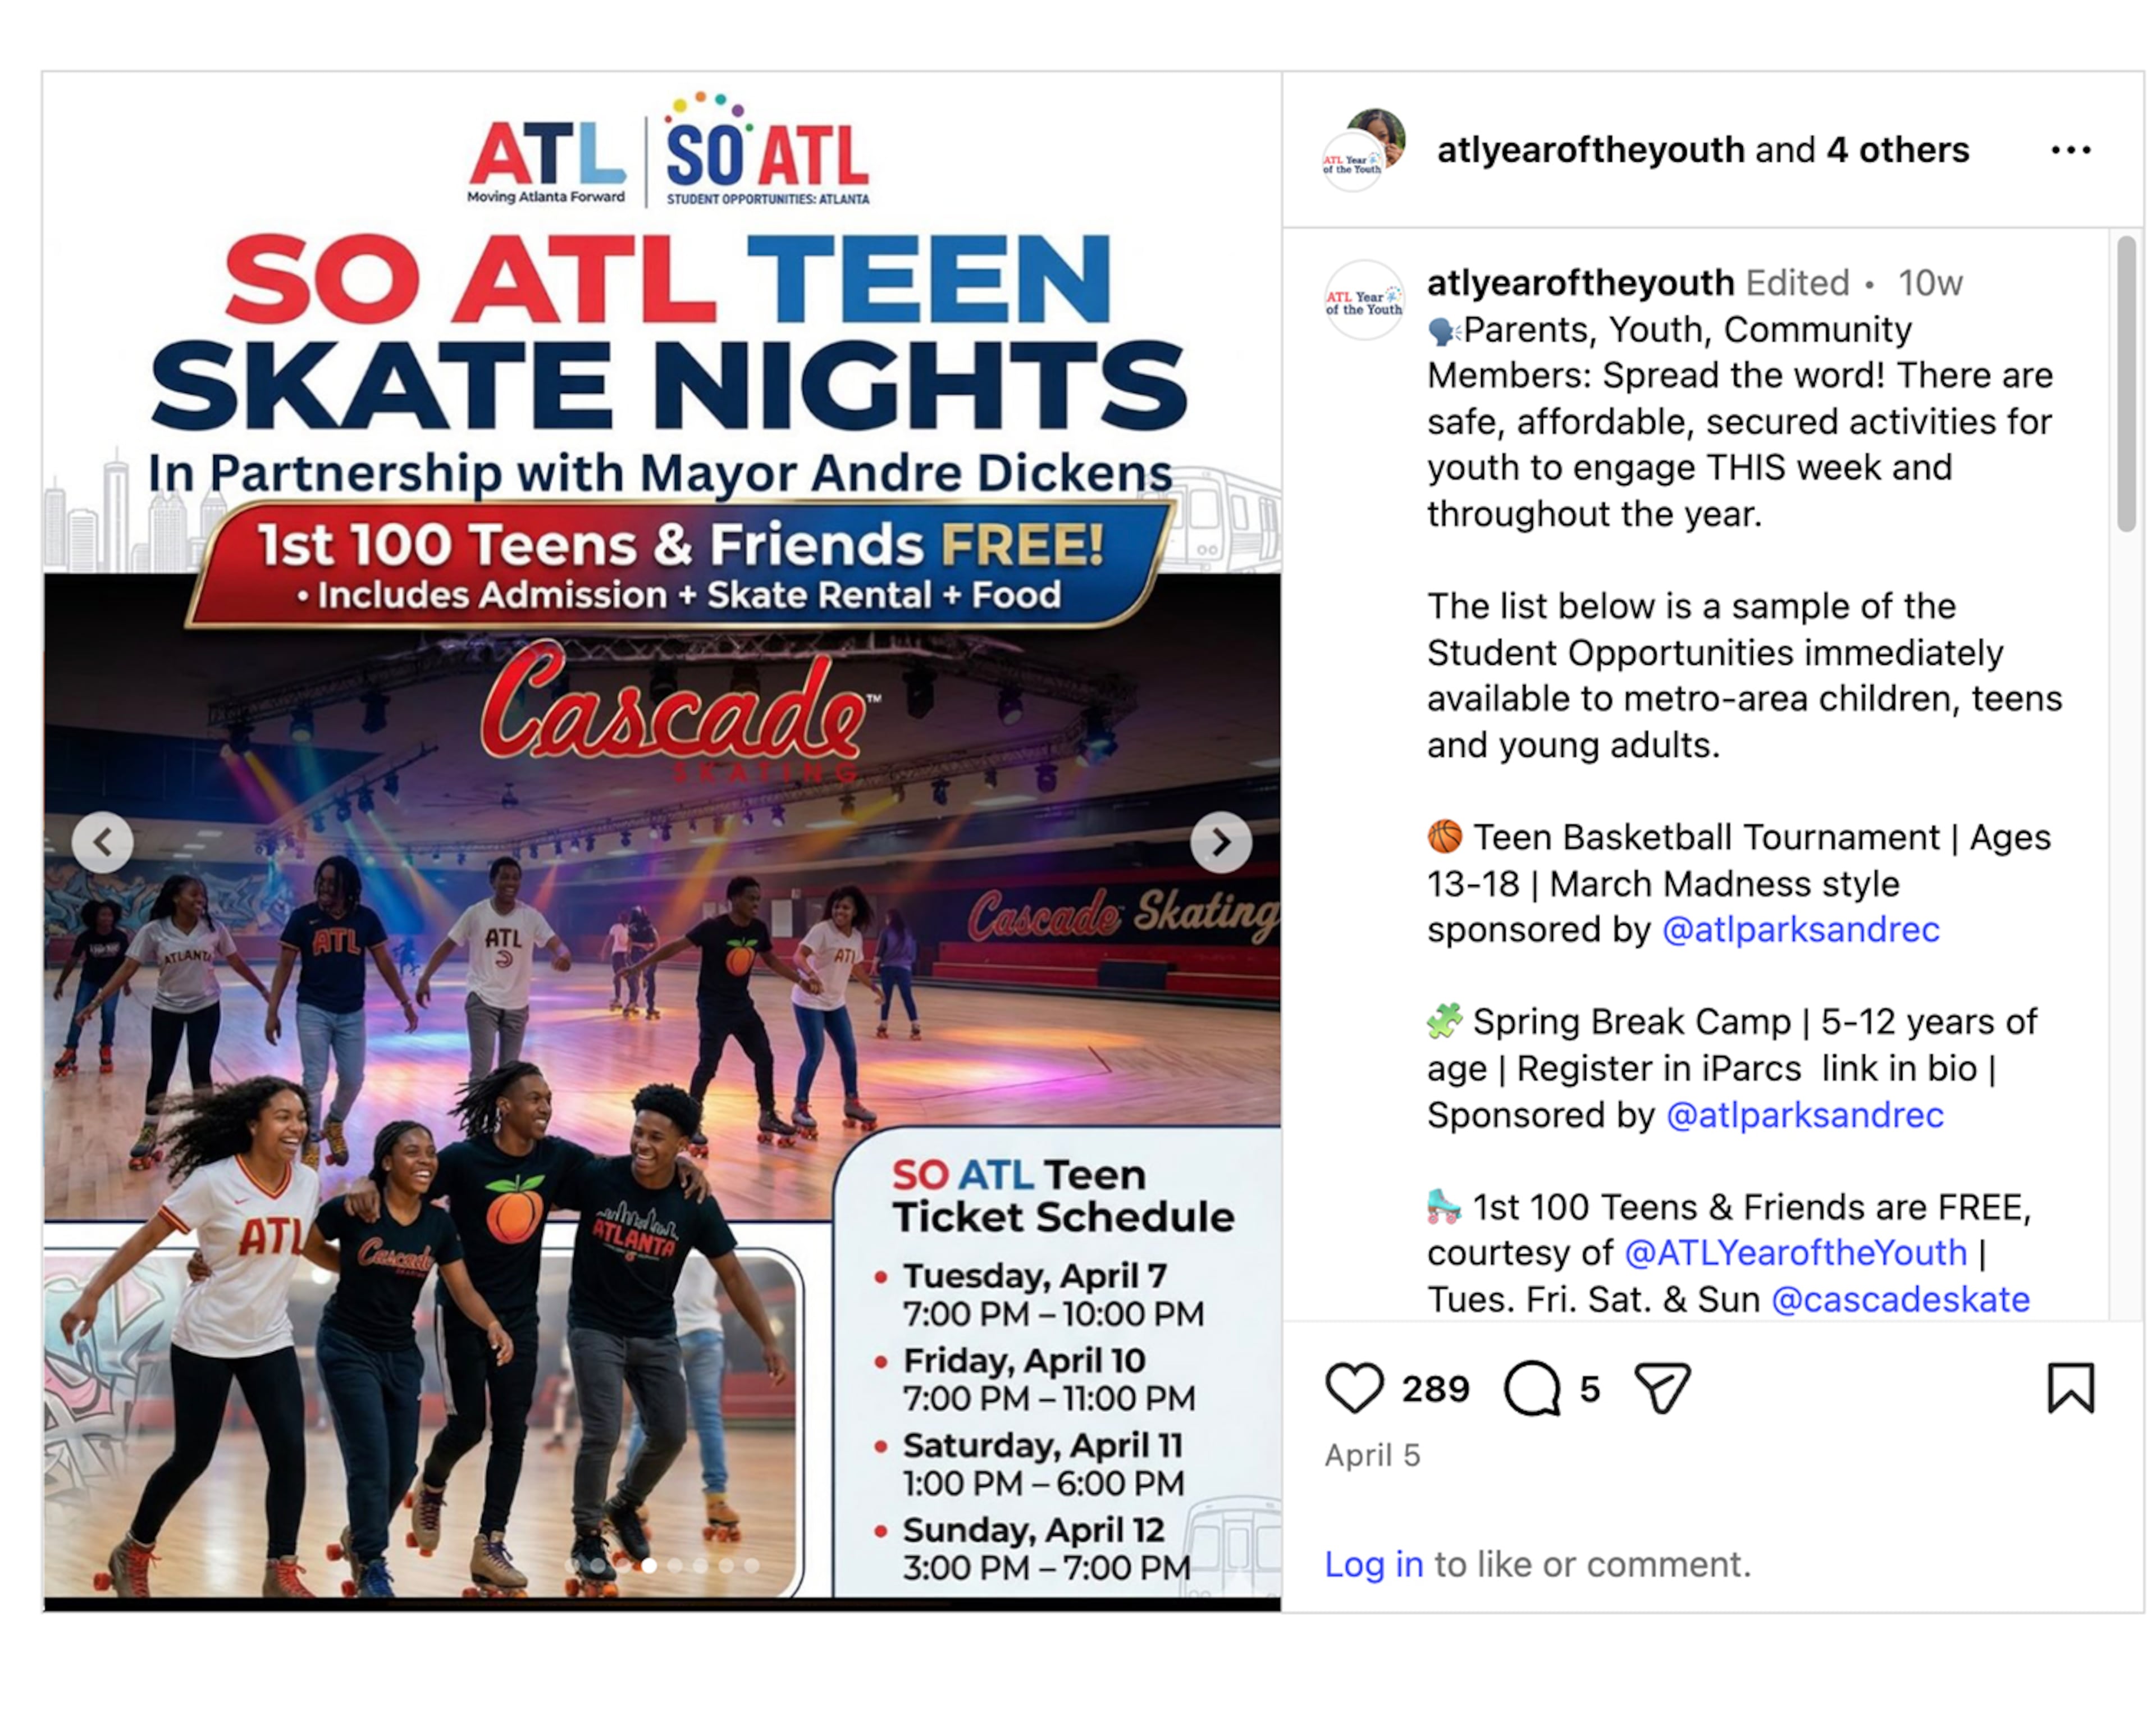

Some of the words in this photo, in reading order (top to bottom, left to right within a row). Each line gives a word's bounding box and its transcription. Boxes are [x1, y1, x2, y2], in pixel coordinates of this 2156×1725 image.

[469, 121, 627, 185] ATL
[666, 124, 744, 186] SO
[758, 125, 870, 185] ATL
[1323, 165, 1333, 174] of
[1336, 165, 1352, 174] the
[1354, 165, 1382, 174] Youth
[1346, 156, 1367, 165] Year
[1438, 134, 1745, 170] atlyearoftheyouth
[1756, 135, 1815, 163] and
[1826, 136, 1849, 163] 4
[1860, 135, 1970, 163] others
[467, 190, 517, 206] Moving
[518, 190, 568, 203] Atlanta
[570, 190, 625, 203] Forward
[667, 193, 720, 205] STUDENT
[722, 193, 817, 205] OPPORTUNITIES:
[819, 193, 870, 205] ATLANTA
[225, 232, 421, 325] SO
[450, 234, 718, 324] ATL
[747, 234, 1111, 324] TEEN
[1427, 267, 1734, 303] atlyearoftheyouth
[1748, 268, 1849, 296] Edited
[1899, 268, 1963, 296] 10w
[1326, 291, 1353, 303] ATL
[1356, 291, 1384, 303] Year
[1326, 304, 1339, 315] of
[1343, 304, 1364, 315] the
[1367, 304, 1403, 315] Youth
[1465, 316, 1596, 349] Parents,
[1609, 314, 1711, 349] Youth,
[1724, 314, 1913, 350] Community
[150, 339, 613, 432] SKATE
[655, 339, 1188, 432] NIGHTS
[1429, 360, 1591, 389] Members:
[1604, 360, 1718, 395] Spread
[1730, 360, 1783, 389] the
[1793, 360, 1884, 389] word!
[1897, 360, 1991, 389] There
[2003, 367, 2053, 389] are
[150, 453, 193, 492] In
[212, 452, 502, 500] Partnership
[517, 452, 624, 492] with
[641, 453, 797, 501] Mayor
[812, 452, 962, 492] Andre
[979, 451, 1173, 492] Dickens
[258, 523, 334, 565] 1st
[350, 523, 451, 565] 100
[468, 523, 637, 565] Teens
[654, 522, 692, 565] &
[712, 519, 924, 565] Friends
[944, 523, 1102, 564] FREE!
[320, 579, 469, 608] Includes
[479, 579, 666, 608] Admission
[709, 580, 807, 608] Skate
[820, 580, 930, 608] Rental
[974, 580, 1060, 608] Food
[1428, 638, 1557, 667] Student
[1569, 637, 1794, 672] Opportunities
[1805, 637, 2004, 673] immediately
[480, 637, 866, 760] Cascade
[673, 761, 858, 783] SKATING
[1473, 823, 1551, 851] Teen
[1564, 822, 1731, 851] Basketball
[1743, 823, 1941, 851] Tournament
[1970, 823, 2052, 857] Ages
[1428, 869, 1520, 897] 13-18
[1551, 869, 1652, 897] March
[1665, 869, 1812, 897] Madness
[1822, 869, 1901, 903] style
[967, 887, 1122, 942] Cascade
[1134, 888, 1280, 946] Skating
[1428, 914, 1600, 949] sponsored
[1614, 914, 1652, 950] by
[1663, 914, 1940, 949] @atlparksandrec
[312, 927, 361, 956] ATL
[485, 928, 523, 948] ATL
[1474, 1006, 1579, 1042] Spring
[1592, 1006, 1685, 1035] Break
[1696, 1007, 1792, 1041] Camp
[1822, 1007, 1895, 1035] 5-12
[1907, 1014, 1995, 1042] years
[2006, 1006, 2039, 1035] of
[1428, 1060, 1487, 1088] age
[1519, 1053, 1653, 1088] Register
[1664, 1053, 1691, 1081] in
[1703, 1053, 1802, 1081] iParcs
[1824, 1053, 1879, 1081] link
[1889, 1053, 1916, 1081] in
[1929, 1053, 1977, 1081] bio
[893, 1158, 950, 1191] SO
[958, 1158, 1035, 1190] ATL
[1043, 1158, 1146, 1190] Teen
[892, 1198, 1025, 1233] Ticket
[1036, 1199, 1235, 1233] Schedule
[1474, 1193, 1520, 1221] 1st
[1531, 1193, 1589, 1221] 100
[1601, 1193, 1698, 1221] Teens
[1709, 1193, 1734, 1221] &
[1745, 1192, 1865, 1221] Friends
[1876, 1199, 1927, 1221] are
[1940, 1193, 2031, 1227] FREE,
[239, 1217, 303, 1256] ATL
[592, 1218, 677, 1258] ATLANTA
[902, 1261, 1051, 1295] Tuesday,
[1059, 1260, 1139, 1295] April
[1148, 1263, 1168, 1289] 7
[903, 1300, 971, 1327] 7:00
[981, 1301, 1029, 1326] PM
[1063, 1300, 1145, 1327] 10:00
[1155, 1300, 1203, 1327] PM
[1427, 1285, 1514, 1313] Tues.
[1528, 1284, 1576, 1313] Fri.
[1589, 1285, 1651, 1313] Sat.
[1663, 1285, 1688, 1313] &
[1698, 1285, 1760, 1313] Sun
[1773, 1284, 2030, 1317] @cascadeskate
[905, 1345, 1015, 1381] Friday,
[1023, 1345, 1102, 1380] April
[1111, 1347, 1146, 1374] 10
[903, 1385, 971, 1412] 7:00
[981, 1385, 1029, 1411] PM
[1063, 1385, 1136, 1412] 11:00
[1147, 1385, 1195, 1411] PM
[1403, 1375, 1470, 1403] 289
[1581, 1375, 1601, 1403] 5
[903, 1431, 1062, 1465] Saturday,
[1069, 1430, 1149, 1465] April
[1158, 1432, 1182, 1458] 11
[1324, 1442, 1391, 1472] April
[1404, 1443, 1420, 1467] 5
[903, 1470, 964, 1496] 1:00
[975, 1470, 1022, 1496] PM
[1057, 1470, 1126, 1496] 6:00
[1135, 1470, 1184, 1496] PM
[903, 1515, 1037, 1550] Sunday,
[1044, 1514, 1123, 1549] April
[1132, 1516, 1165, 1543] 12
[903, 1555, 971, 1581] 3:00
[981, 1555, 1029, 1580] PM
[1063, 1554, 1131, 1581] 7:00
[1141, 1555, 1190, 1580] PM
[1326, 1550, 1385, 1584] Log
[1397, 1549, 1423, 1577] in
[1435, 1552, 1467, 1577] to
[1479, 1549, 1532, 1577] like
[1543, 1557, 1577, 1577] or
[1588, 1552, 1751, 1577] comment.
